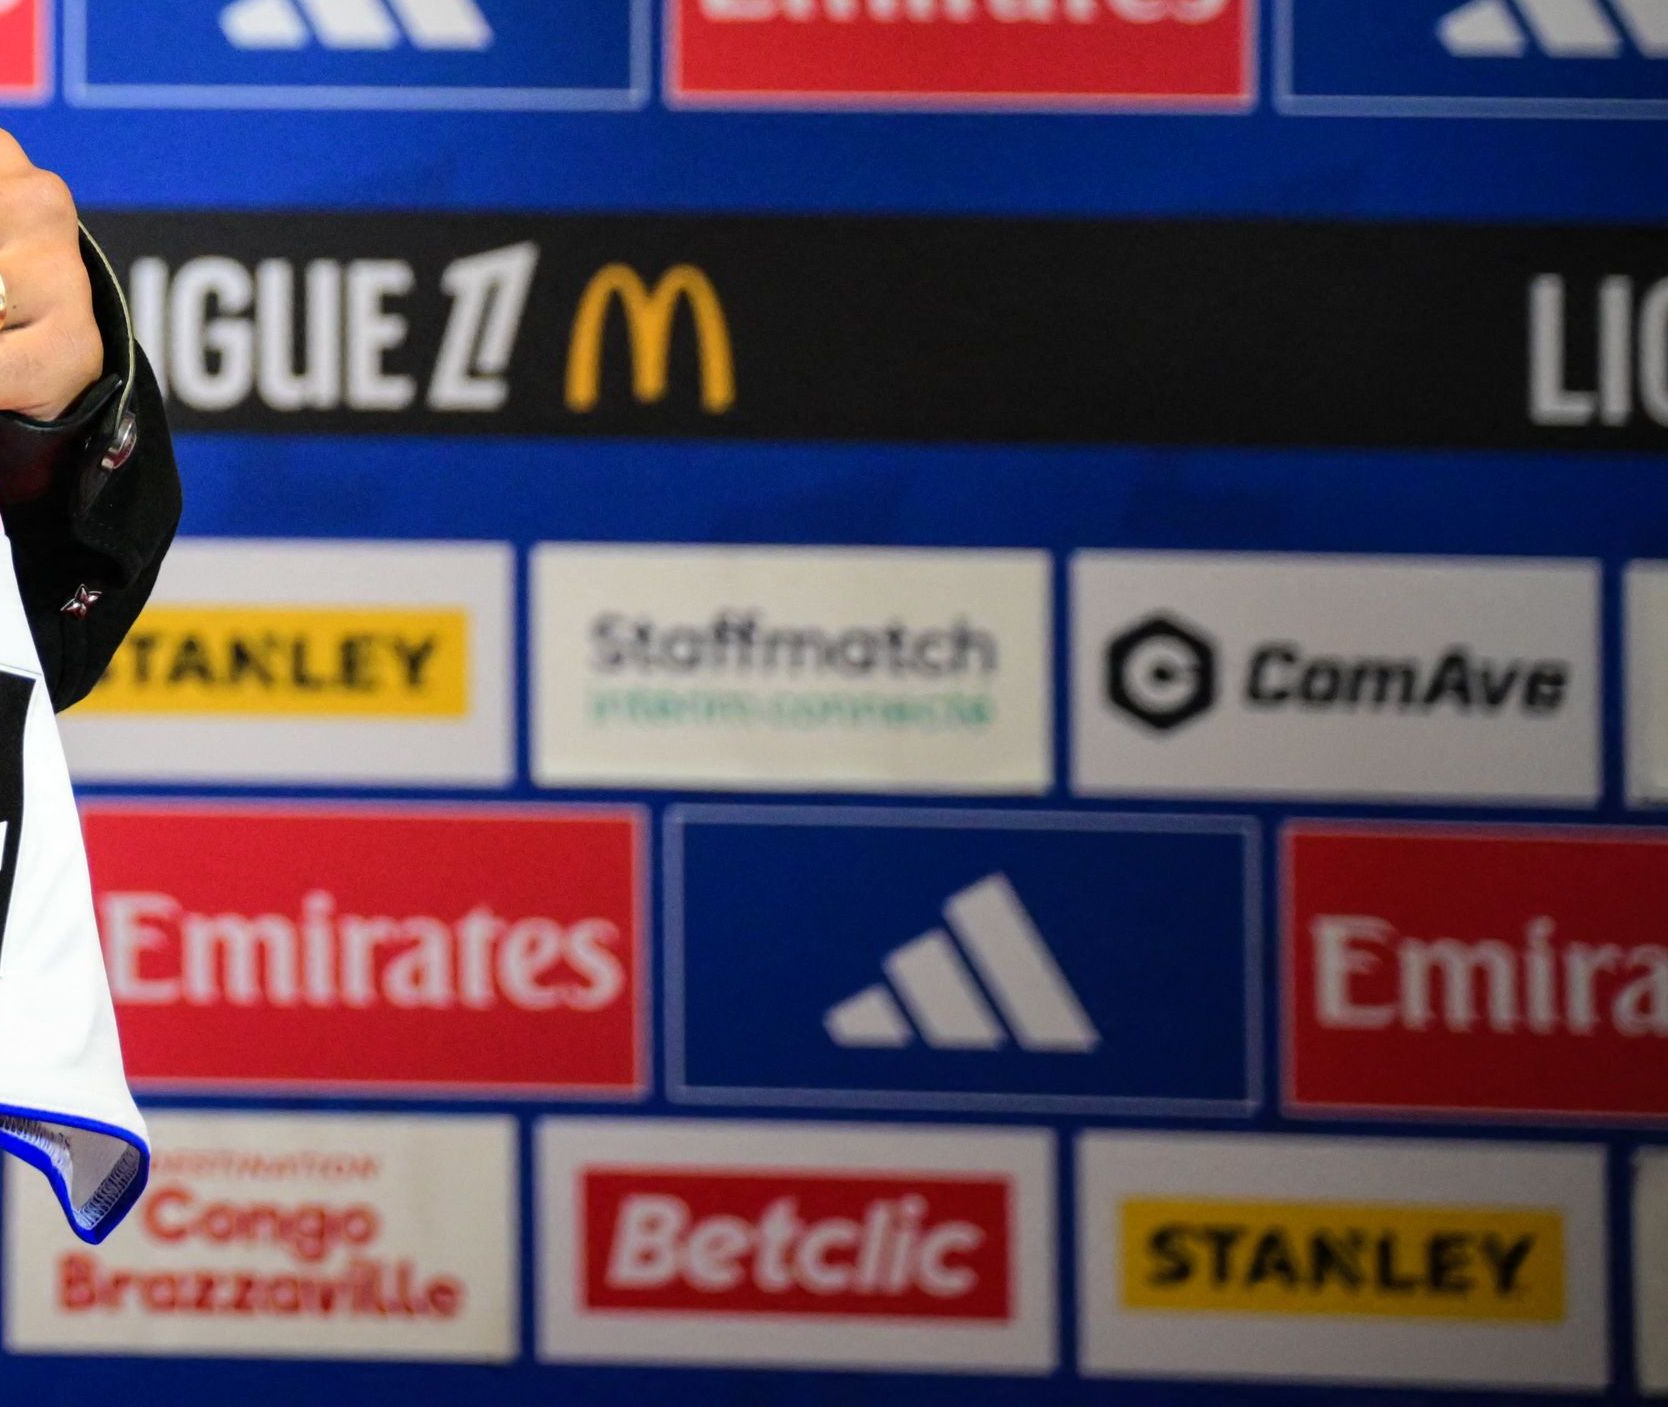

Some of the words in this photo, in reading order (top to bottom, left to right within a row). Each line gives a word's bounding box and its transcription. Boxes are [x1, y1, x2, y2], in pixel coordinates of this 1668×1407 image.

[129, 252, 418, 412] IGUE
[98, 622, 444, 696] TANLEY
[593, 611, 1000, 681] Staffmatch
[1244, 645, 1569, 716] ComAve
[108, 884, 628, 1014] Emirates
[1310, 915, 1668, 1033] Emira
[142, 1188, 381, 1262] Congo
[607, 1194, 979, 1295] Betclic
[58, 1254, 465, 1319] Brazzaville
[1149, 1226, 1536, 1300] STANLEY
